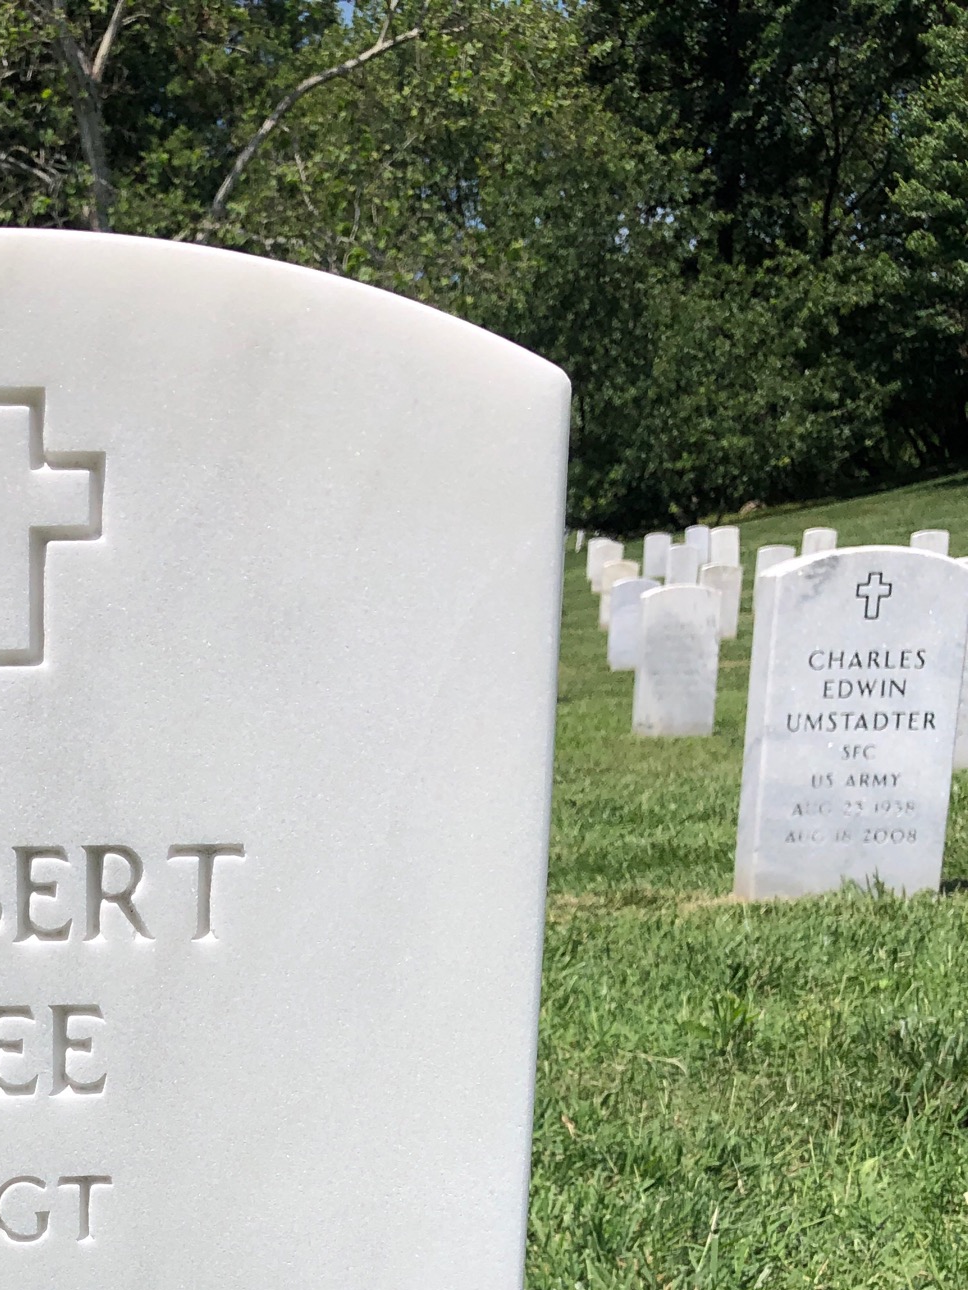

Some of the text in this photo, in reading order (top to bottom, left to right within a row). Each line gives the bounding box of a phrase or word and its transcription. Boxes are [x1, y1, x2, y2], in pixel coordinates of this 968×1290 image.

[808, 649, 926, 671] CHARLES
[822, 679, 907, 699] EDWIN
[786, 711, 936, 733] UMSTADTER
[841, 744, 877, 761] SFC
[811, 772, 901, 789] US ARMY
[863, 828, 918, 845] 2008
